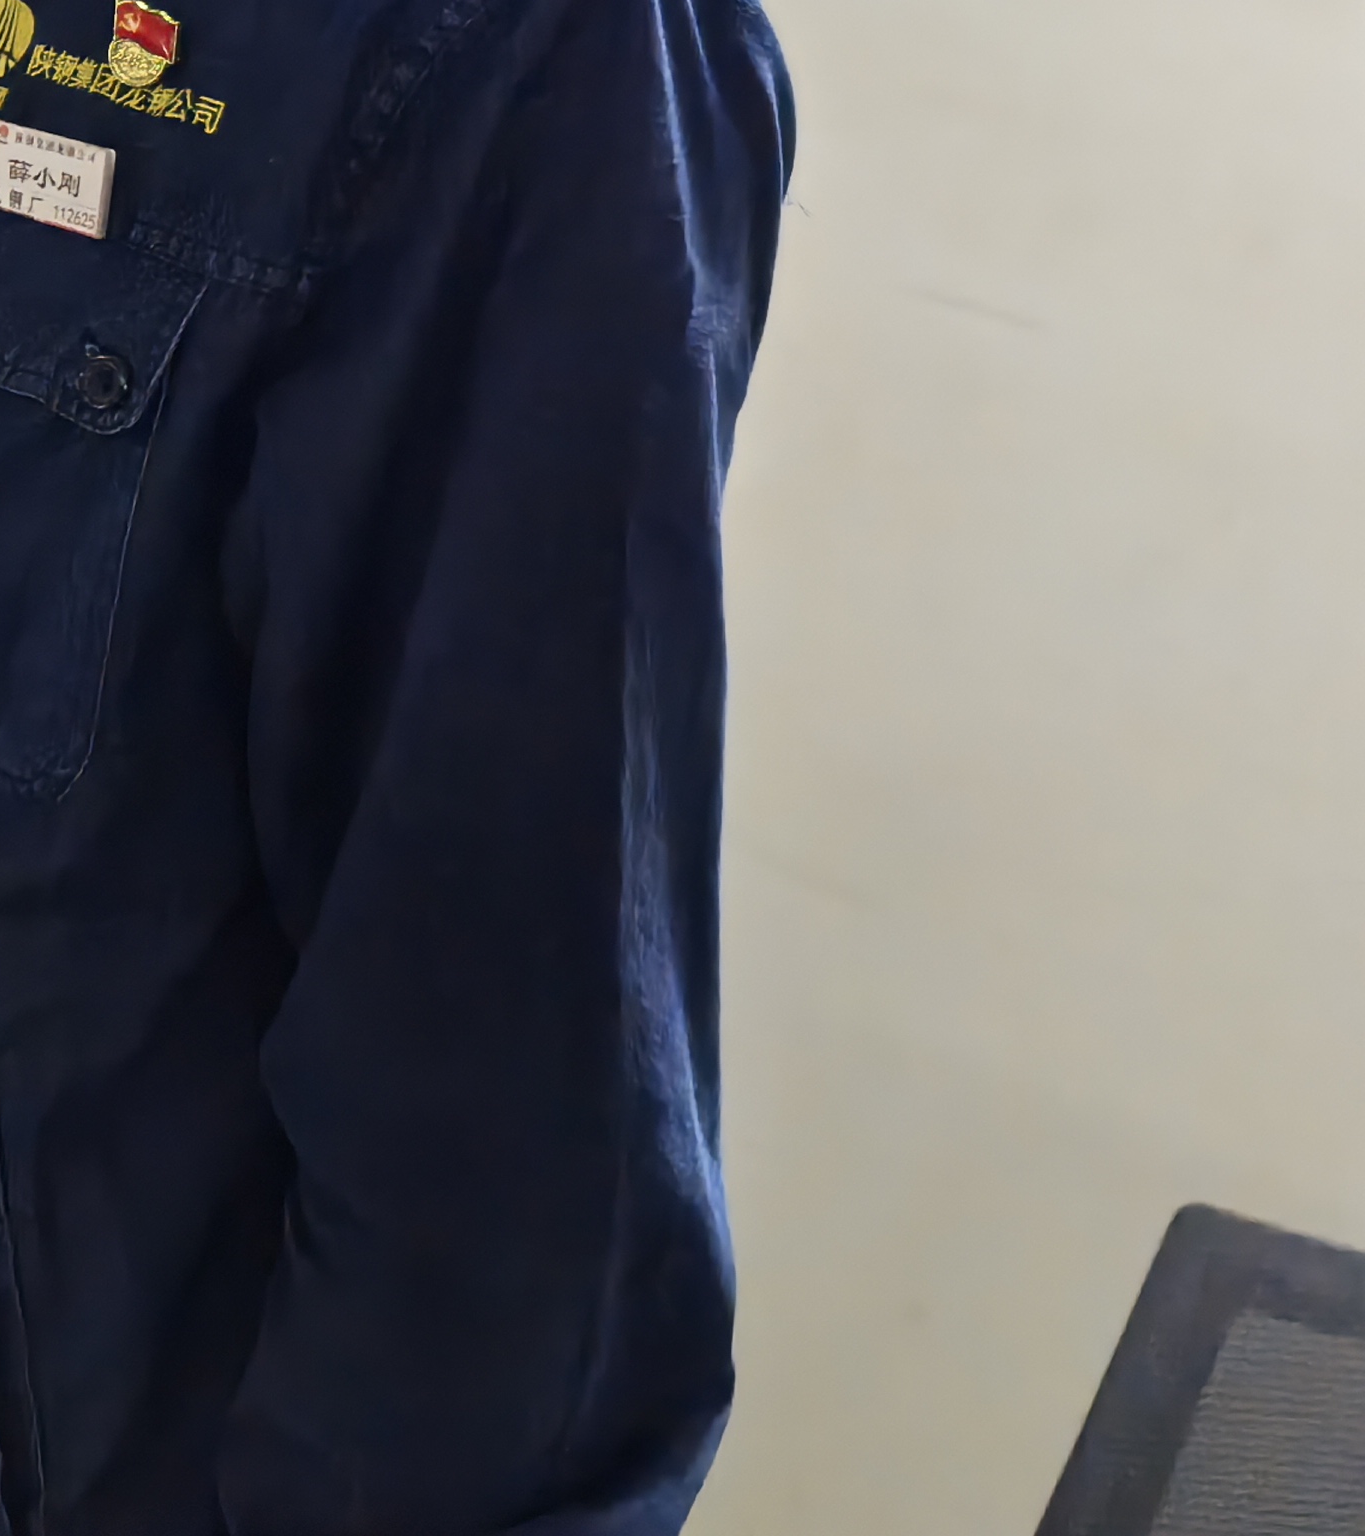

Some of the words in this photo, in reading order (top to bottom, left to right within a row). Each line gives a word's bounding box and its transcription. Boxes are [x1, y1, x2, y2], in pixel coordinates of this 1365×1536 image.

[8, 158, 82, 198] 薛小刚
[52, 205, 97, 230] 112625
